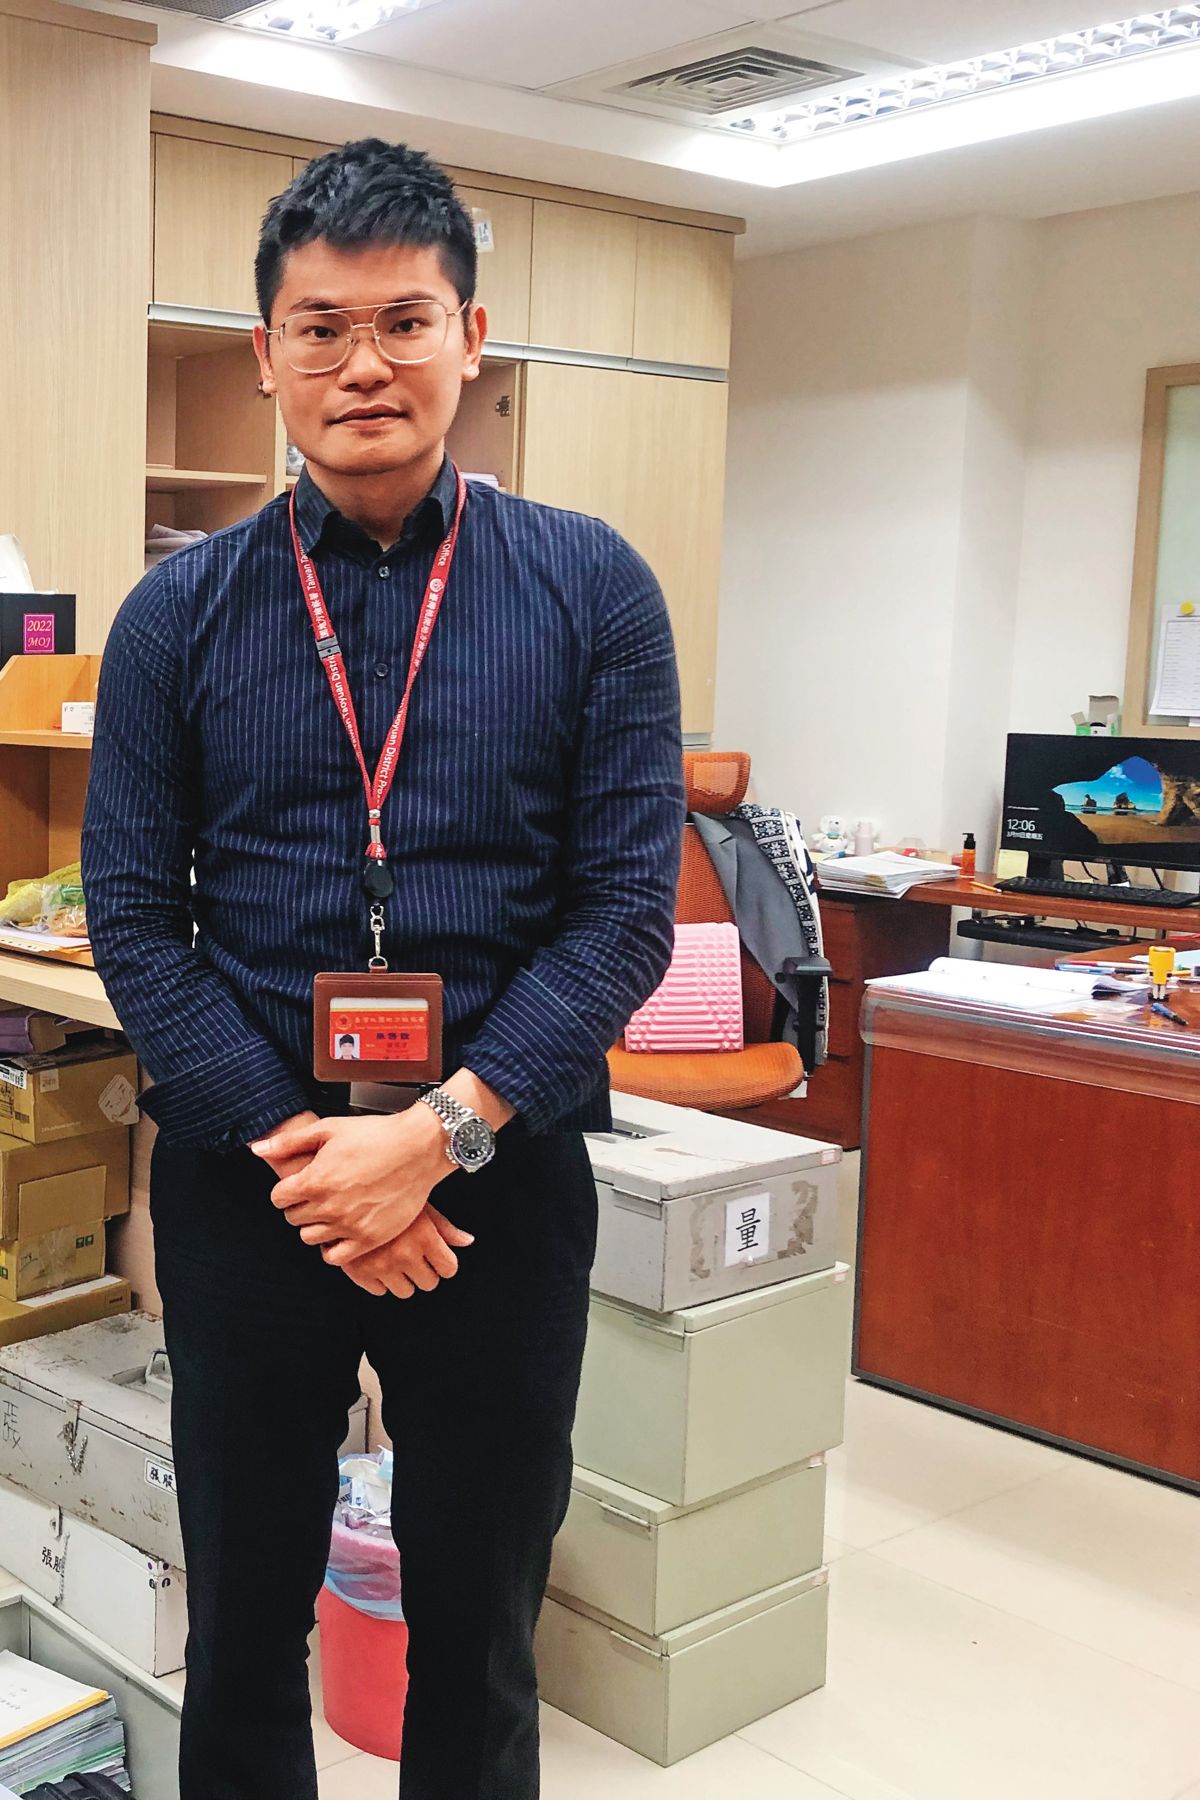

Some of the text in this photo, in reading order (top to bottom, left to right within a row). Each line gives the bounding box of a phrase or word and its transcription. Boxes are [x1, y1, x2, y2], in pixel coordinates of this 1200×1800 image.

[303, 563, 317, 591] Taiwan
[27, 620, 52, 632] 2022
[27, 636, 52, 648] MOJ
[379, 746, 397, 780] District
[1007, 818, 1036, 832] 12:06
[735, 1207, 761, 1253] 量
